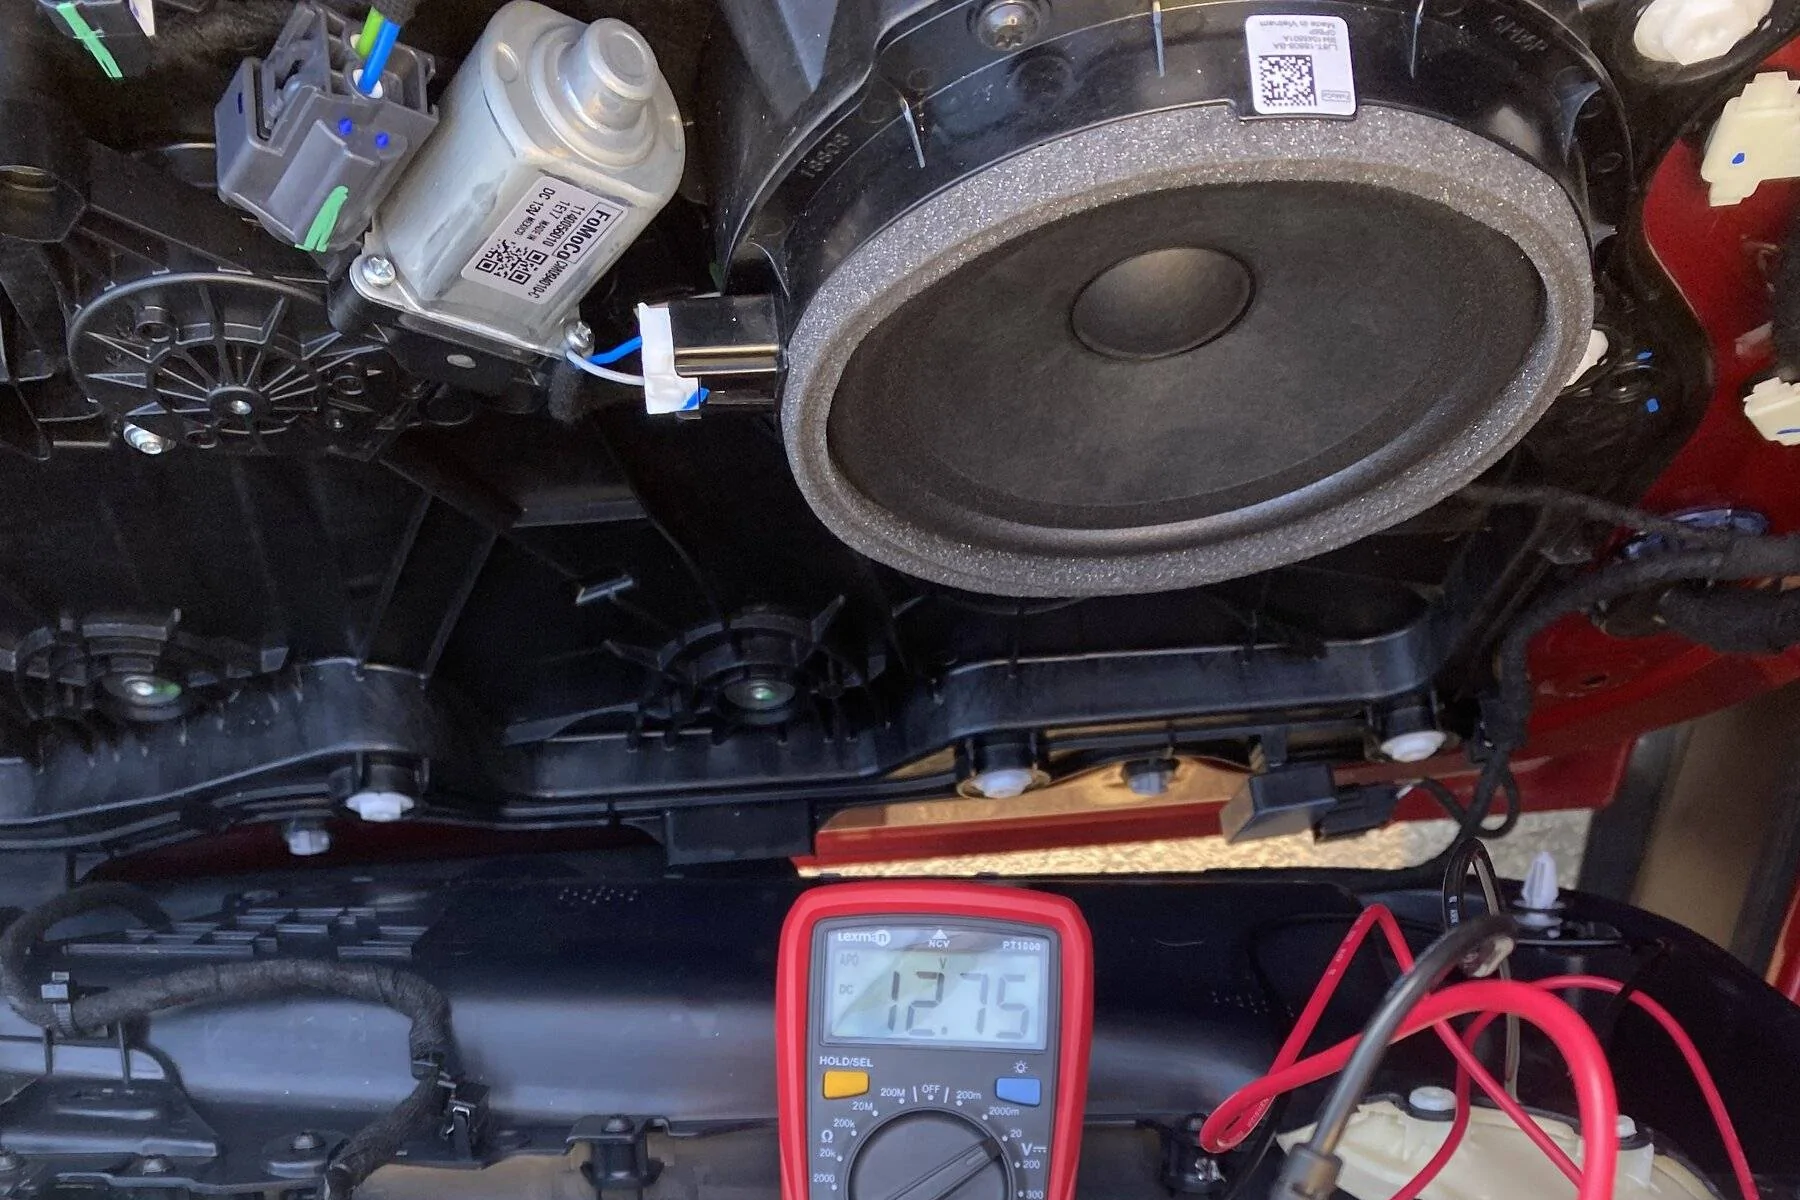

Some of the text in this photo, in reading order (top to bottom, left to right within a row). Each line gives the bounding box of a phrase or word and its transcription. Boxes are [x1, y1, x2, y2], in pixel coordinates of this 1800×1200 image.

[526, 188, 555, 216] DC 13V
[549, 200, 570, 219] 1E17
[557, 209, 611, 260] FoMoCo
[819, 1056, 873, 1068] HOLD/SEL
[880, 1087, 905, 1098] 200M
[922, 1085, 940, 1094] OFF
[956, 1090, 981, 1100] 200m
[852, 1101, 873, 1111] 20M
[989, 1106, 1019, 1116] 2000m
[833, 1118, 855, 1128] 200k
[1010, 1129, 1022, 1138] 20
[1023, 1160, 1040, 1169] 200
[813, 1174, 835, 1183] 2000
[1027, 1190, 1043, 1200] 300
